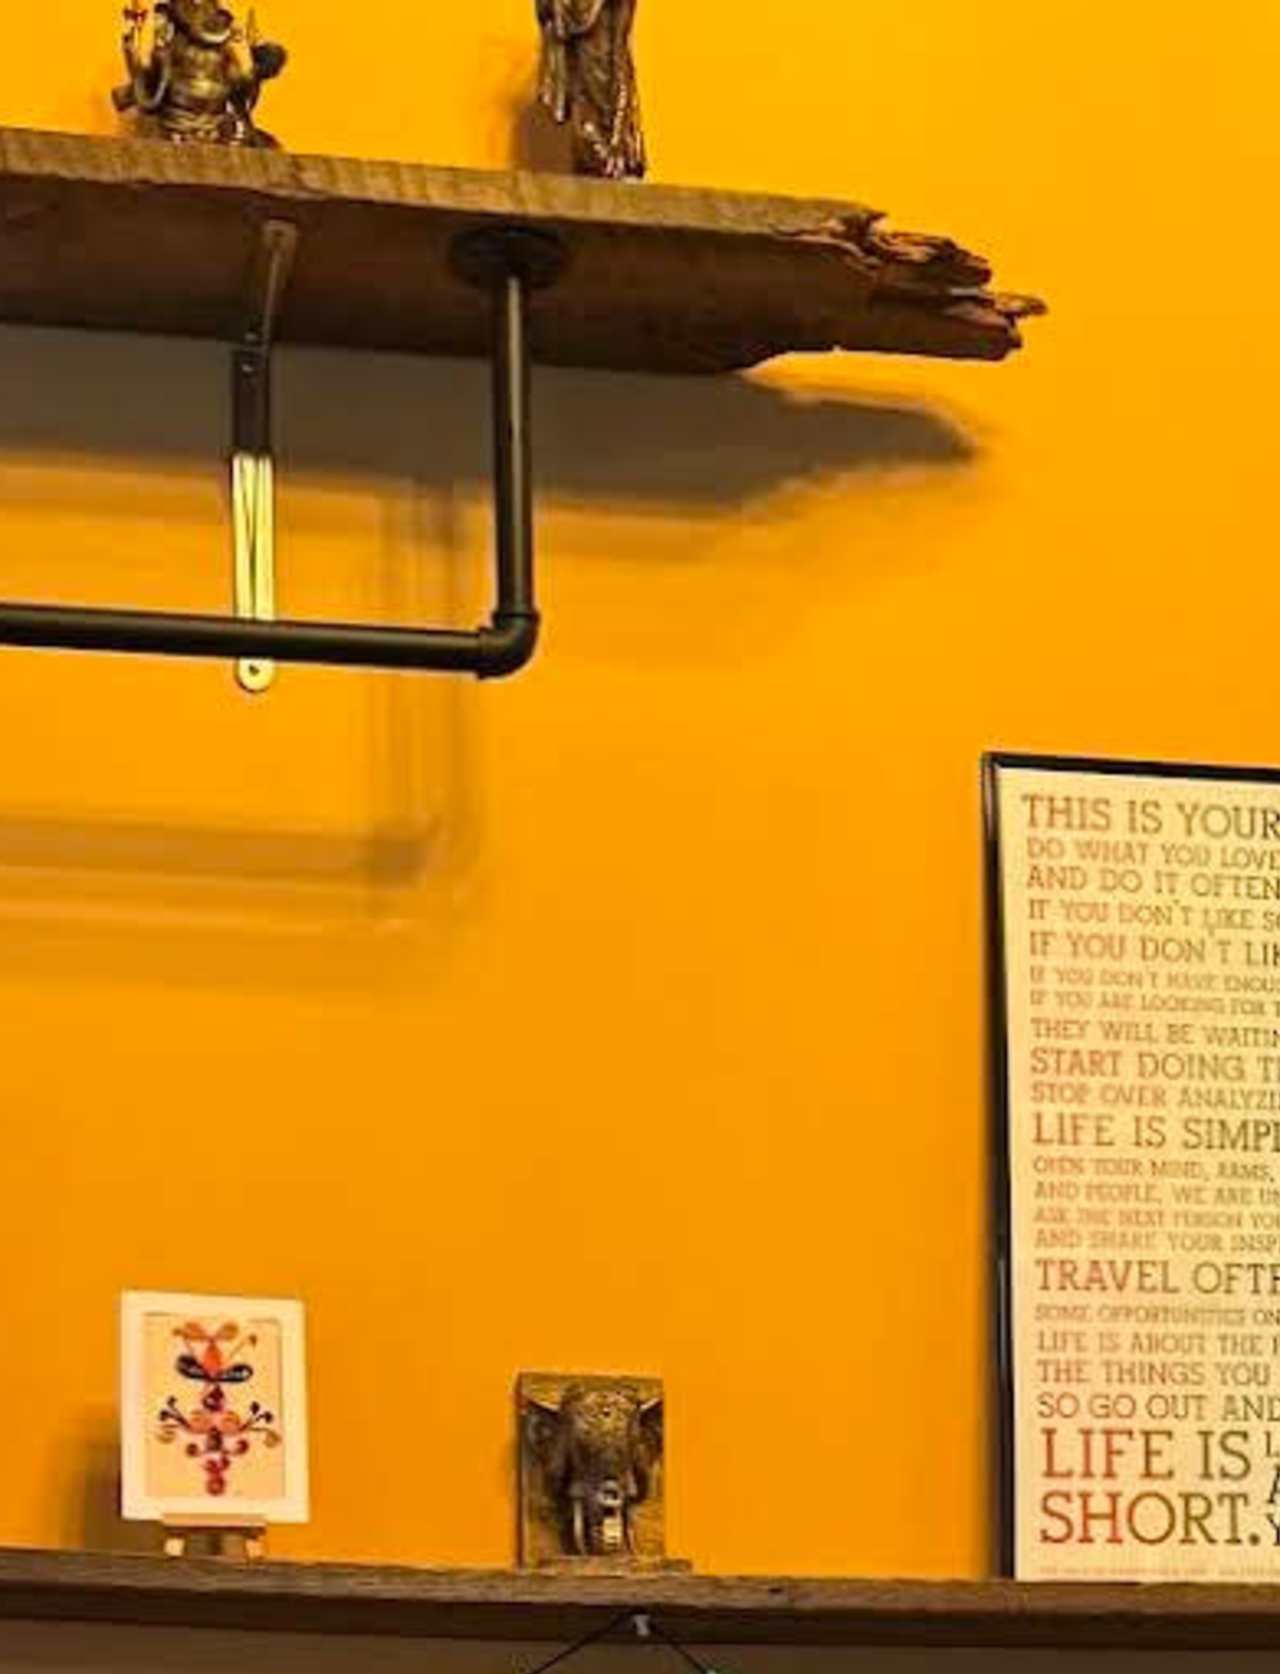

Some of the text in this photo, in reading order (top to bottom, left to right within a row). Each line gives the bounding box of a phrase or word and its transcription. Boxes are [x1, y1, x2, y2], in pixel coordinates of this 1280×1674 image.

[1022, 795, 1111, 830] THIS
[1128, 800, 1162, 834] IS
[1027, 837, 1063, 859] DO
[1076, 840, 1148, 864] WHAT
[1162, 844, 1211, 866] YOU
[1026, 866, 1087, 890] AND
[1100, 869, 1142, 892] DO
[1154, 870, 1179, 895] IT
[1061, 901, 1108, 922] YOU
[1120, 900, 1193, 926] DON'T
[1030, 931, 1055, 957] IF
[1066, 932, 1125, 960] YOU
[1031, 1018, 1090, 1038] THEY
[1098, 1020, 1159, 1043] WILL
[1167, 1024, 1195, 1044] BE
[1030, 1048, 1124, 1077] START
[1138, 1052, 1246, 1081] DOING
[1031, 1083, 1090, 1105] STOP
[1100, 1084, 1167, 1106] OVER
[1032, 1111, 1115, 1147] LIFE
[1133, 1116, 1167, 1148] IS
[1035, 1258, 1179, 1293] TRAVEL
[1037, 1330, 1088, 1352] LIFE
[1099, 1331, 1121, 1352] IS
[1131, 1333, 1205, 1354] ABOUT
[1218, 1334, 1263, 1355] THE
[1036, 1359, 1091, 1384] THE
[1102, 1360, 1206, 1385] THINGS
[1214, 1362, 1270, 1387] YOU
[1037, 1392, 1080, 1419] SO
[1089, 1394, 1137, 1419] GO
[1146, 1394, 1209, 1420] OUT
[1040, 1427, 1251, 1480] LIFE IS
[1040, 1490, 1260, 1545] SHORT.
